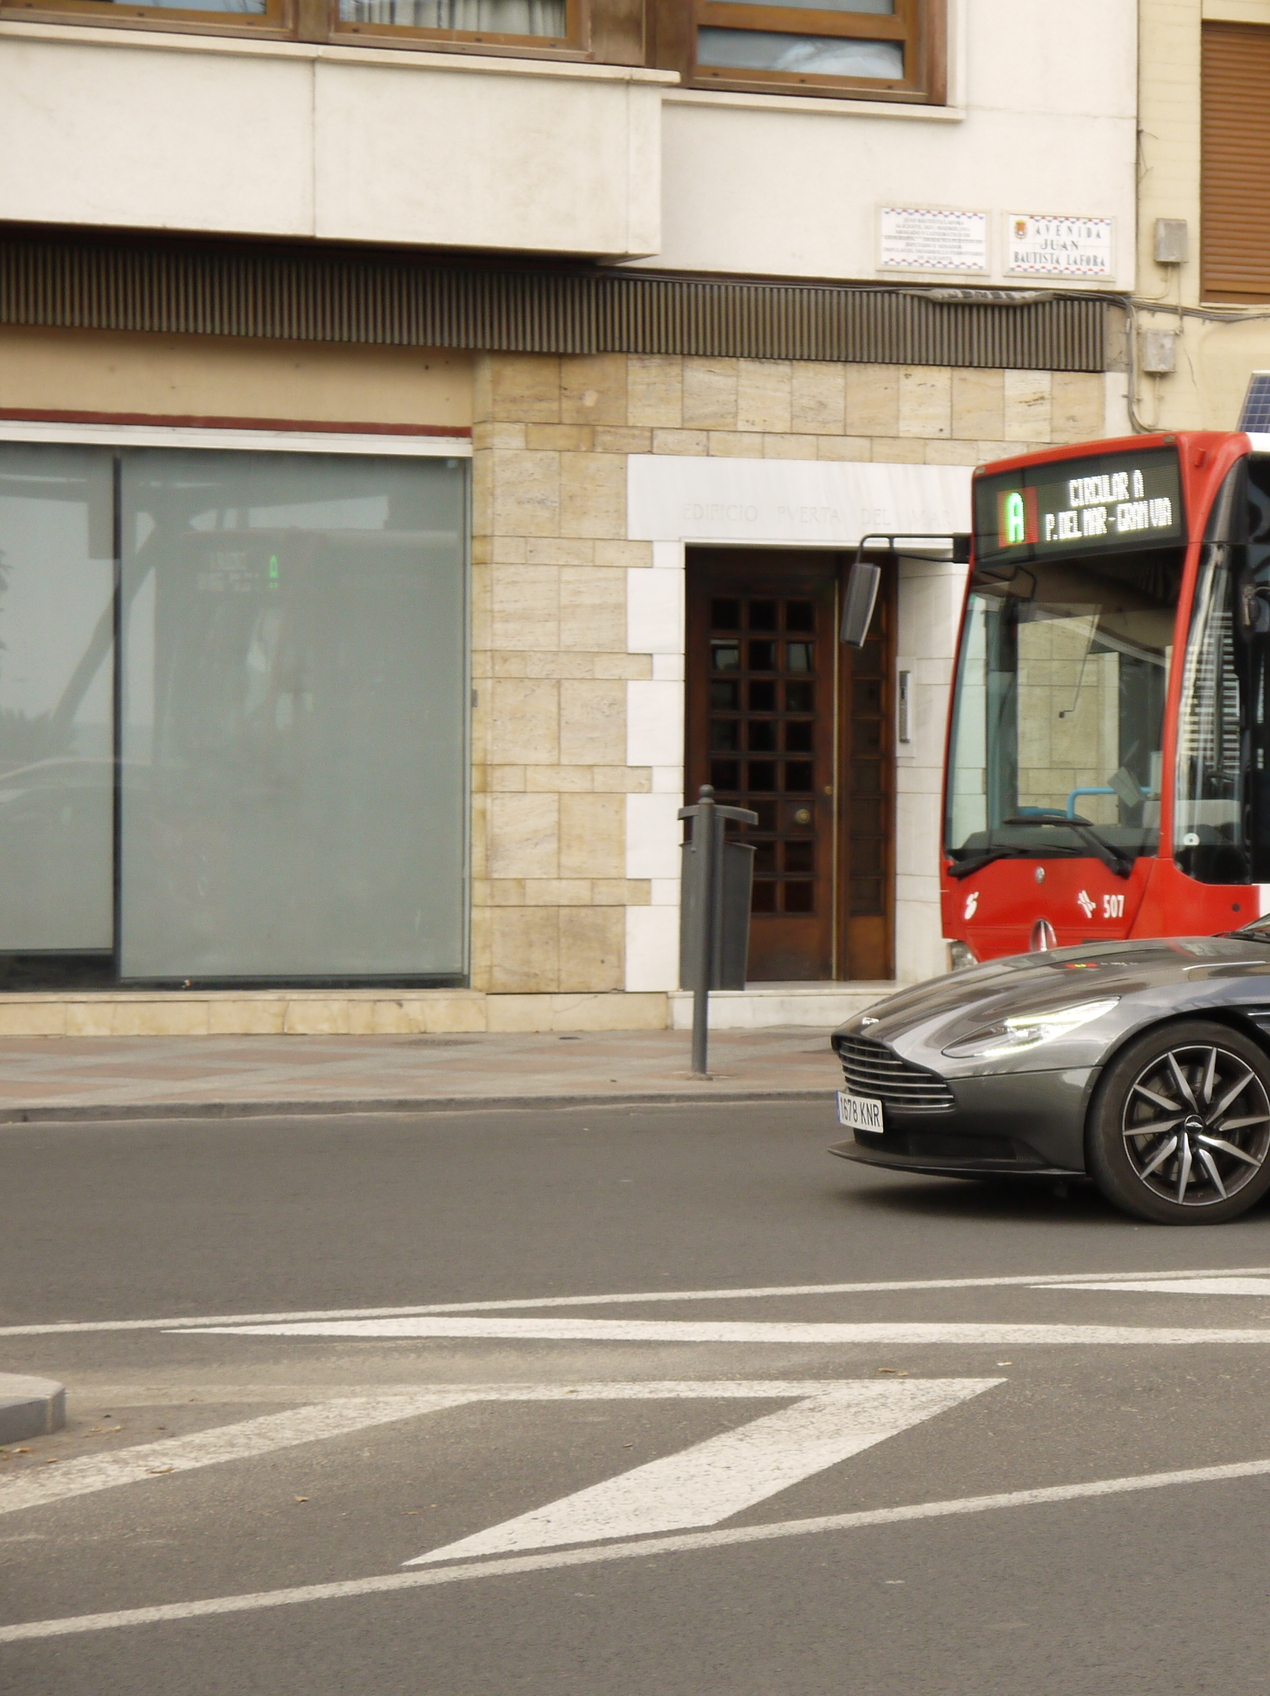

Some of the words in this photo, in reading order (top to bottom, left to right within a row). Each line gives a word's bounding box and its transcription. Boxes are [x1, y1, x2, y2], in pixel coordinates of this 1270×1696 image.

[1035, 224, 1102, 239] AVENIDA
[1040, 238, 1079, 251] JUAN
[1014, 251, 1061, 265] BAUTISTA
[1066, 253, 1106, 267] LAFORA
[1068, 471, 1130, 507] CIRCULAR
[1132, 469, 1145, 498] A
[683, 503, 758, 522] EDIFICIO
[861, 508, 892, 526] DEL
[1007, 492, 1025, 543] A
[1149, 497, 1173, 527] VIA
[1102, 895, 1125, 918] 507
[860, 1103, 880, 1127] KNR
